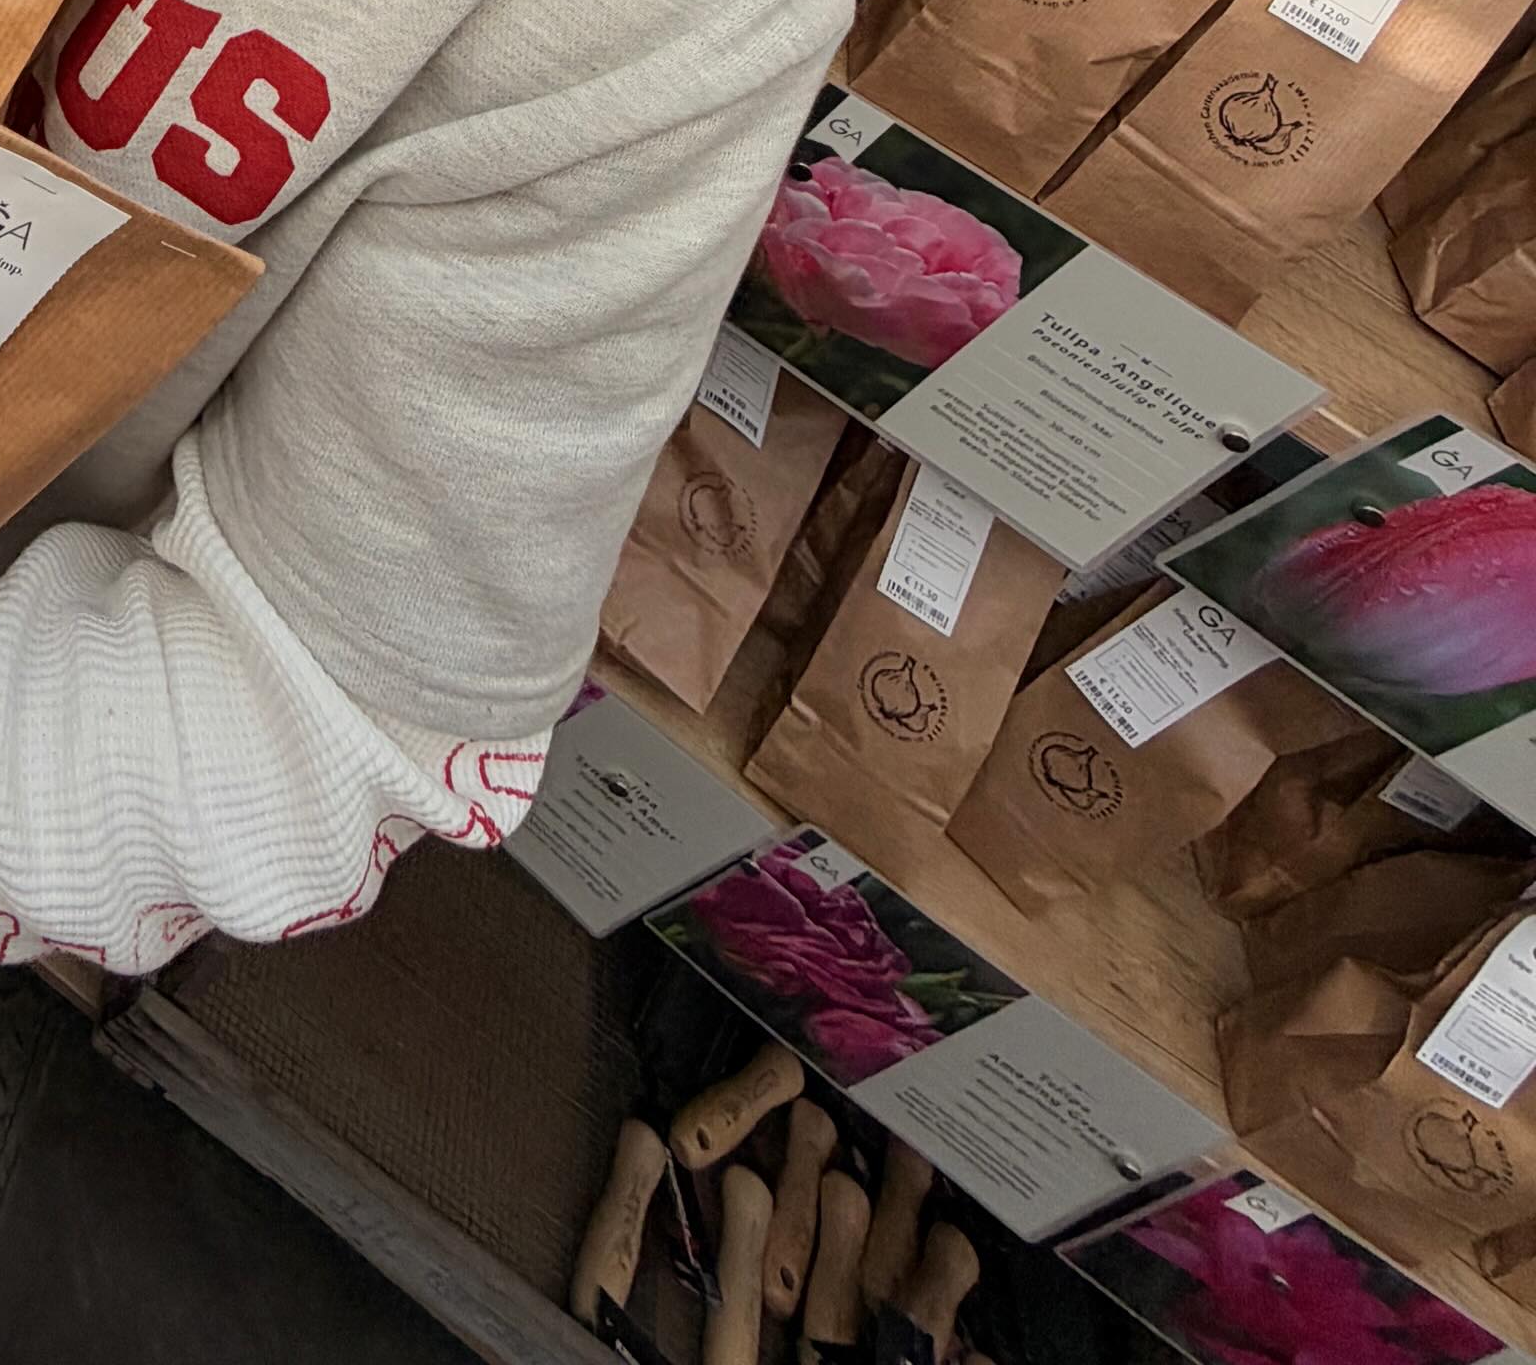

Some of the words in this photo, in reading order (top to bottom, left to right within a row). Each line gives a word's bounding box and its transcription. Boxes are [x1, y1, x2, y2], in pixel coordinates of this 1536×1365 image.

[1319, 3, 1350, 26] 12,00
[1041, 312, 1101, 356] Tulipa
[1163, 410, 1205, 440] Tulpe
[1198, 605, 1236, 647] GA
